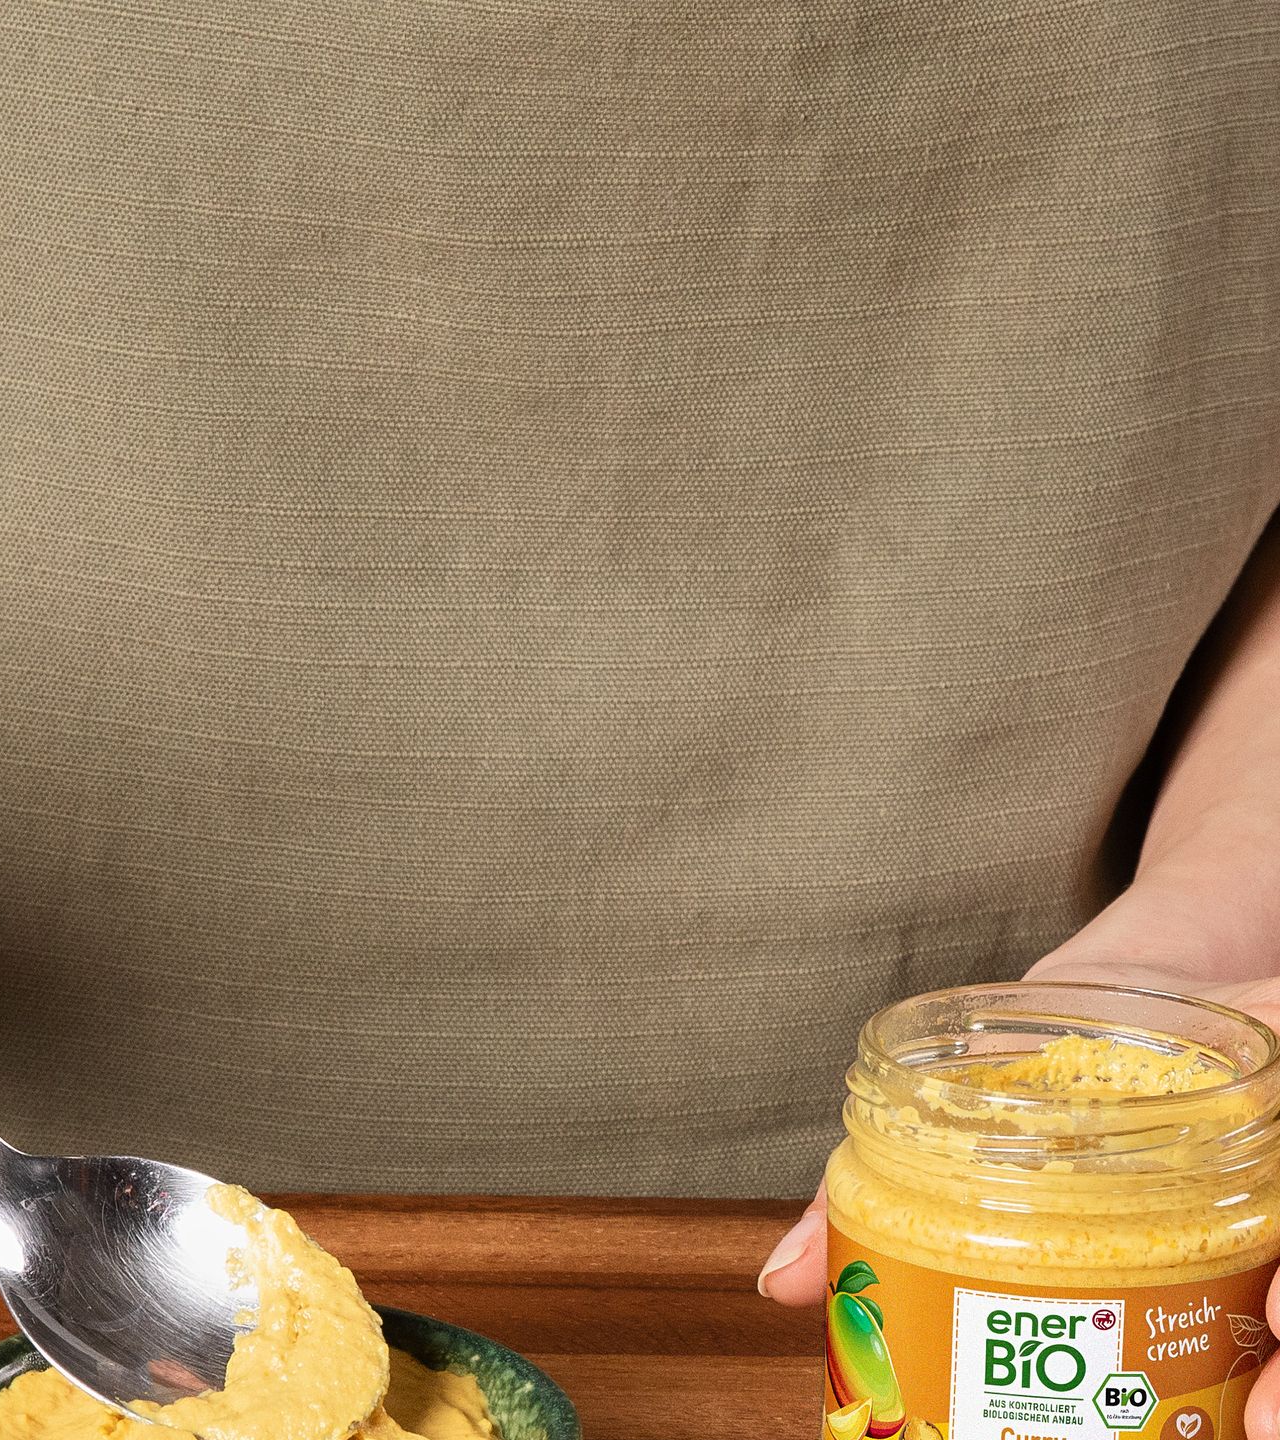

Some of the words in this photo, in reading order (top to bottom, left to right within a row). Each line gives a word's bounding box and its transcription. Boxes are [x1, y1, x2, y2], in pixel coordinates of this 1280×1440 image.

[986, 1309, 1087, 1339] ener
[1146, 1296, 1221, 1339] Streich-
[1147, 1333, 1210, 1361] creme
[983, 1409, 1050, 1424] BIOLOGISCHEM
[1051, 1414, 1084, 1426] ANBAU
[988, 1399, 1007, 1409] AUS
[1008, 1400, 1077, 1414] KONTROLLIERT
